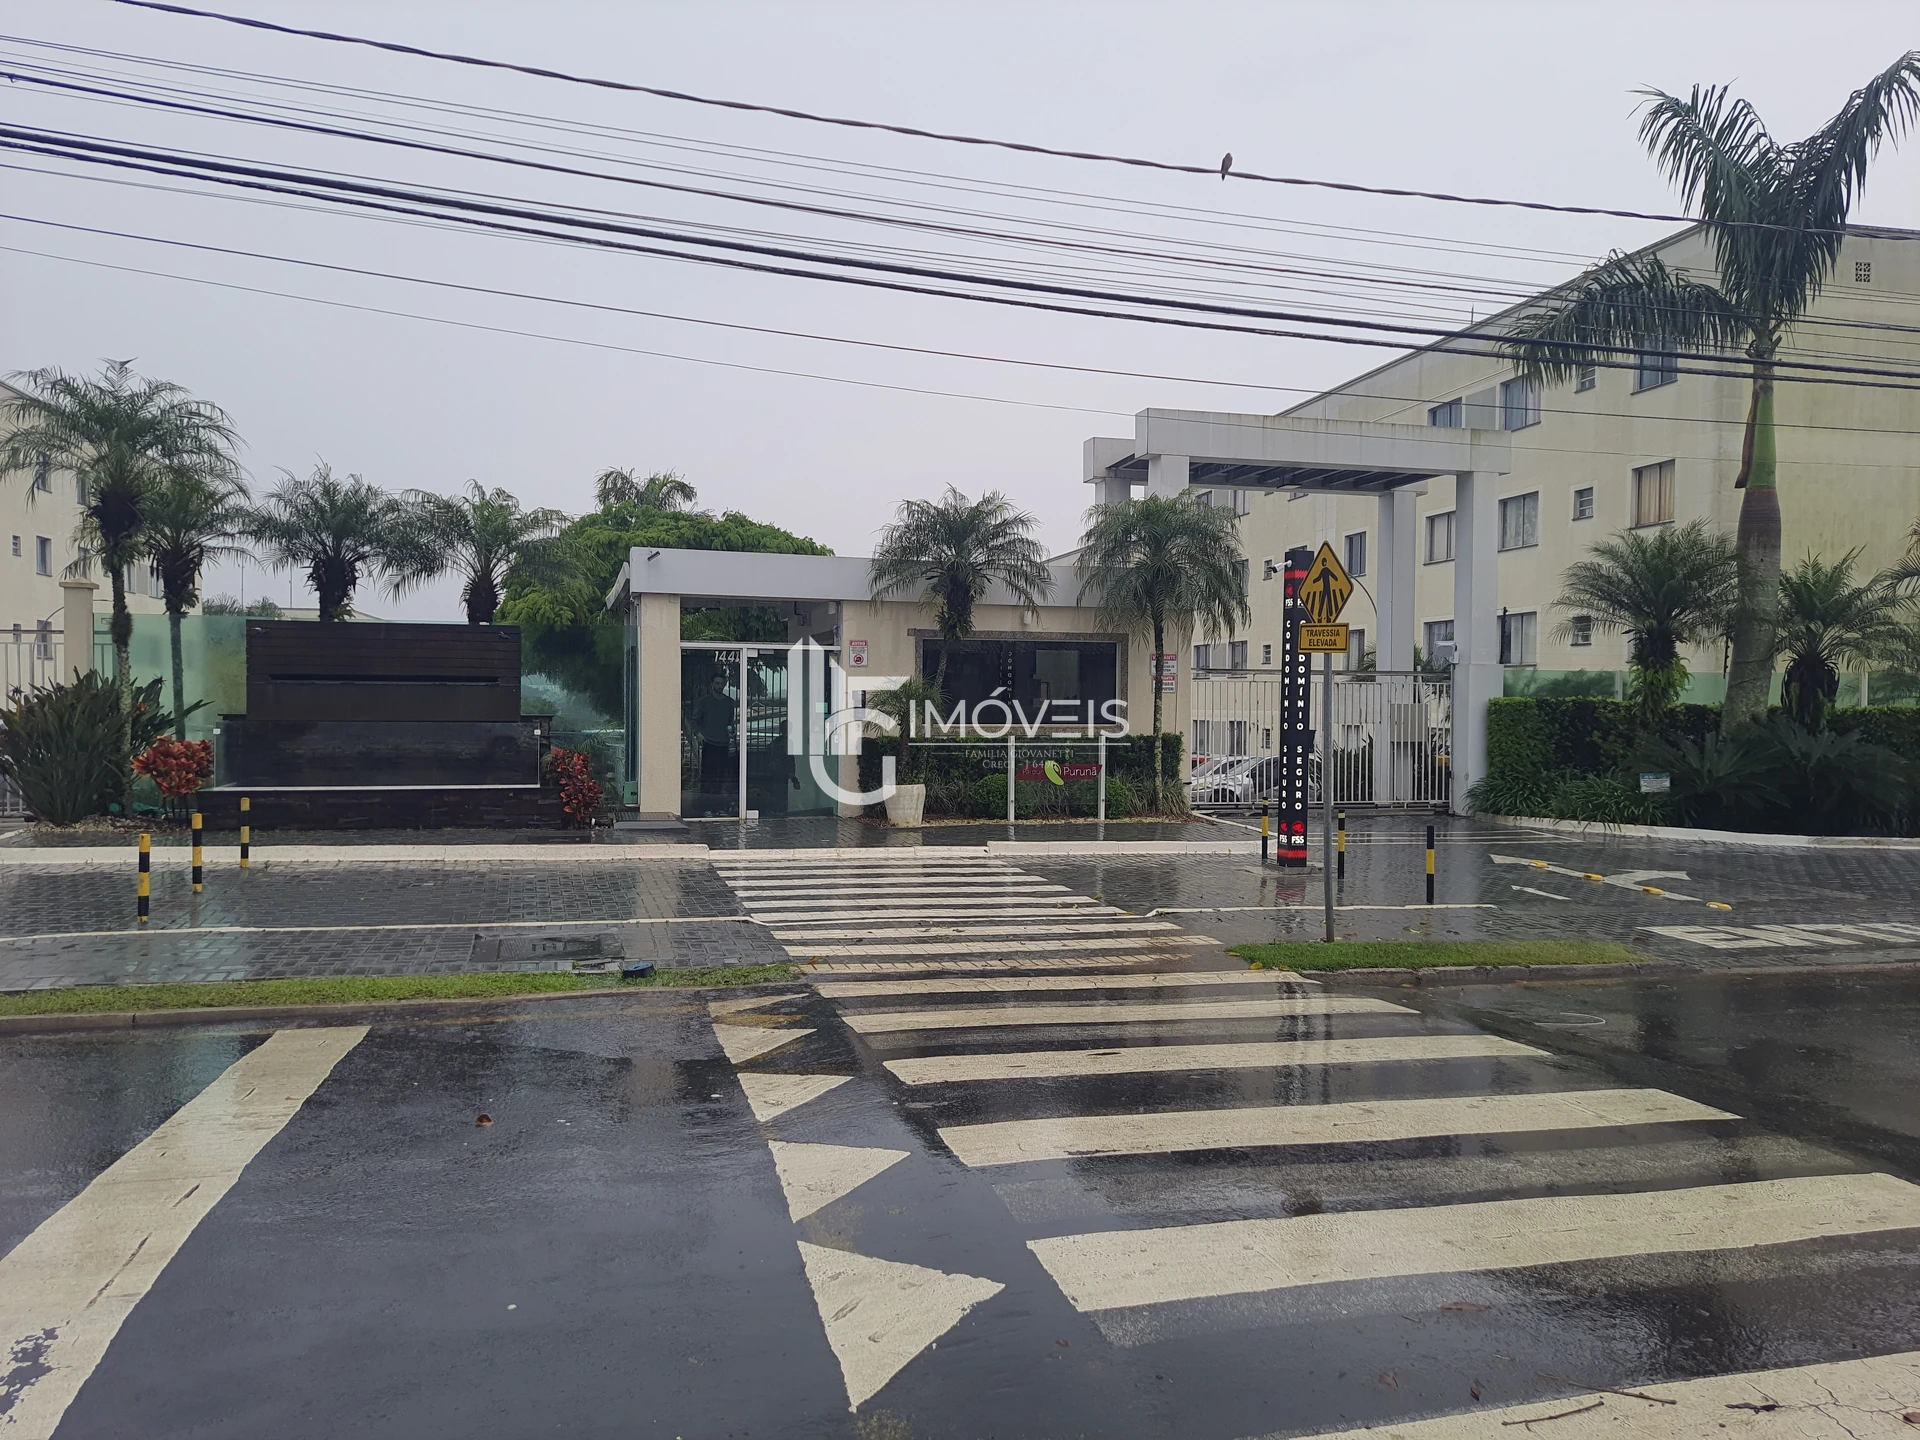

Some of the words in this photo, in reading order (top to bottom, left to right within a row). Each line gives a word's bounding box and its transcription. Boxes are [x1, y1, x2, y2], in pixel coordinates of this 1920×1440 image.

[1306, 629, 1340, 638] TRAVESSIA
[1308, 638, 1337, 647] ELEVADA
[1296, 620, 1306, 731] DOMÍNIO
[1063, 766, 1097, 776] Purunã
[1295, 745, 1303, 810] SEGURO
[1291, 835, 1305, 844] FSS
